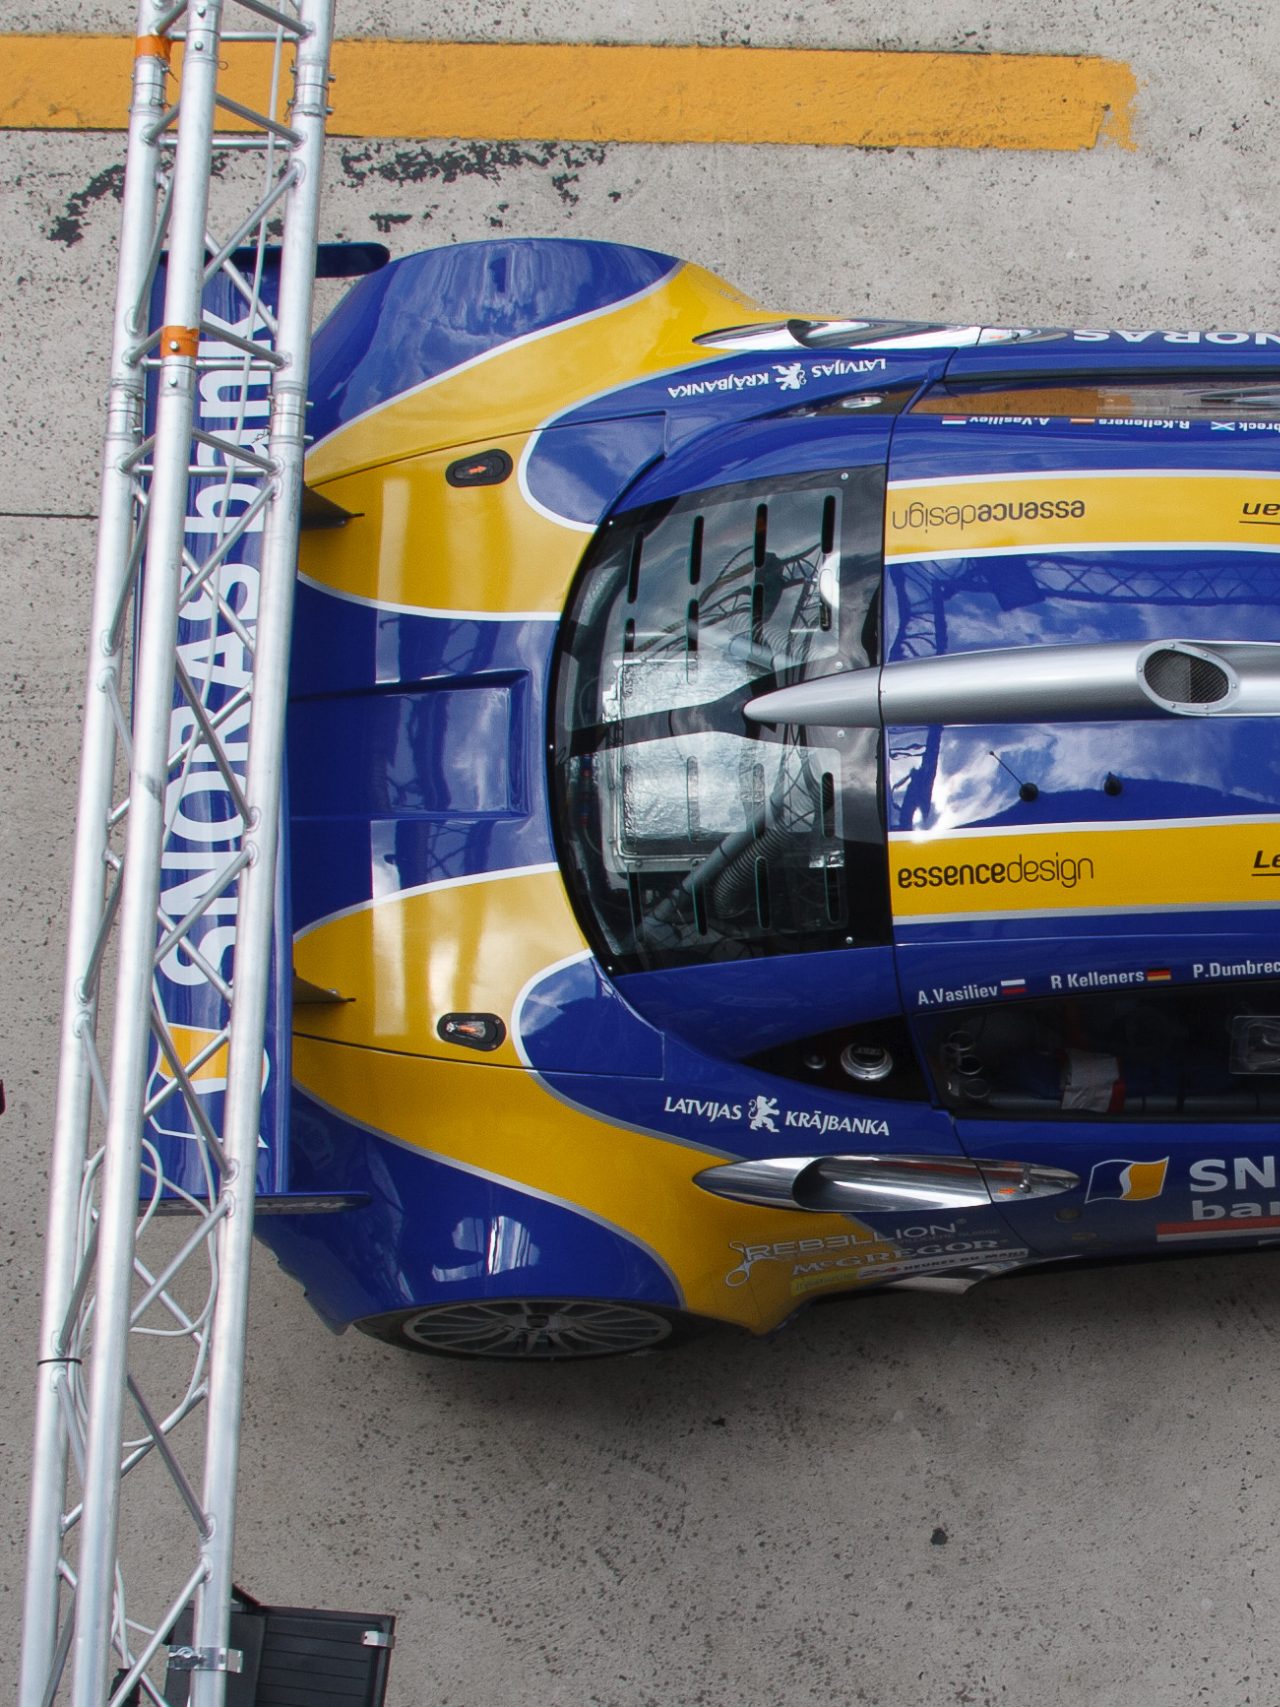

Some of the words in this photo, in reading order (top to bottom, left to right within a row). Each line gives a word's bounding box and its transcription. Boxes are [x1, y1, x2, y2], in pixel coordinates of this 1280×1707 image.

[811, 358, 887, 379] LATVIJAS
[184, 305, 273, 534] bank
[892, 499, 1086, 534] essencedesign
[159, 562, 261, 986] SNORAS
[897, 851, 1094, 889] essencedesign
[917, 983, 999, 1006] A.Vasiliev
[1067, 969, 1146, 988] Kelleners
[664, 1097, 742, 1123] LATVIJAS
[785, 1110, 891, 1137] KRĀJBANKA
